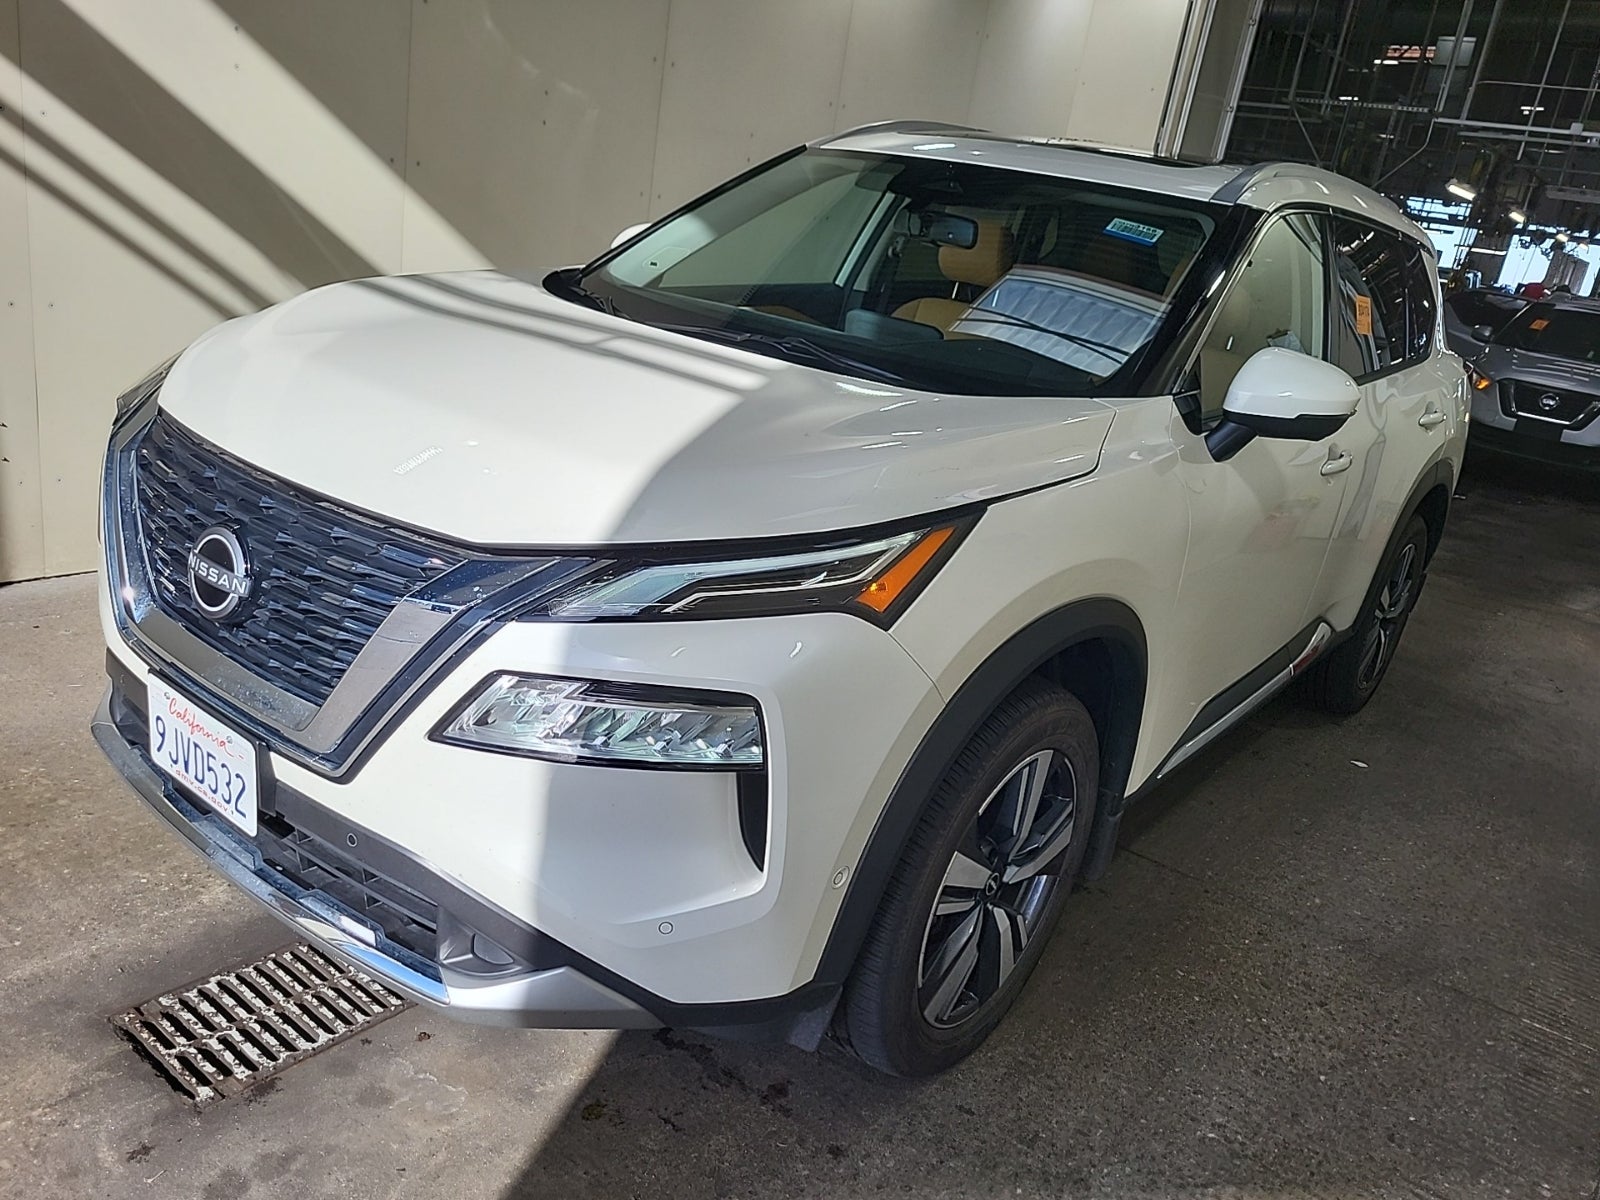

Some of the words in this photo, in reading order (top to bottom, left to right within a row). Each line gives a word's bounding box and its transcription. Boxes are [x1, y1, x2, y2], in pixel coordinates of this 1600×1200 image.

[188, 552, 247, 594] NISSAN
[169, 697, 234, 757] California
[155, 714, 247, 819] 9JVD532
